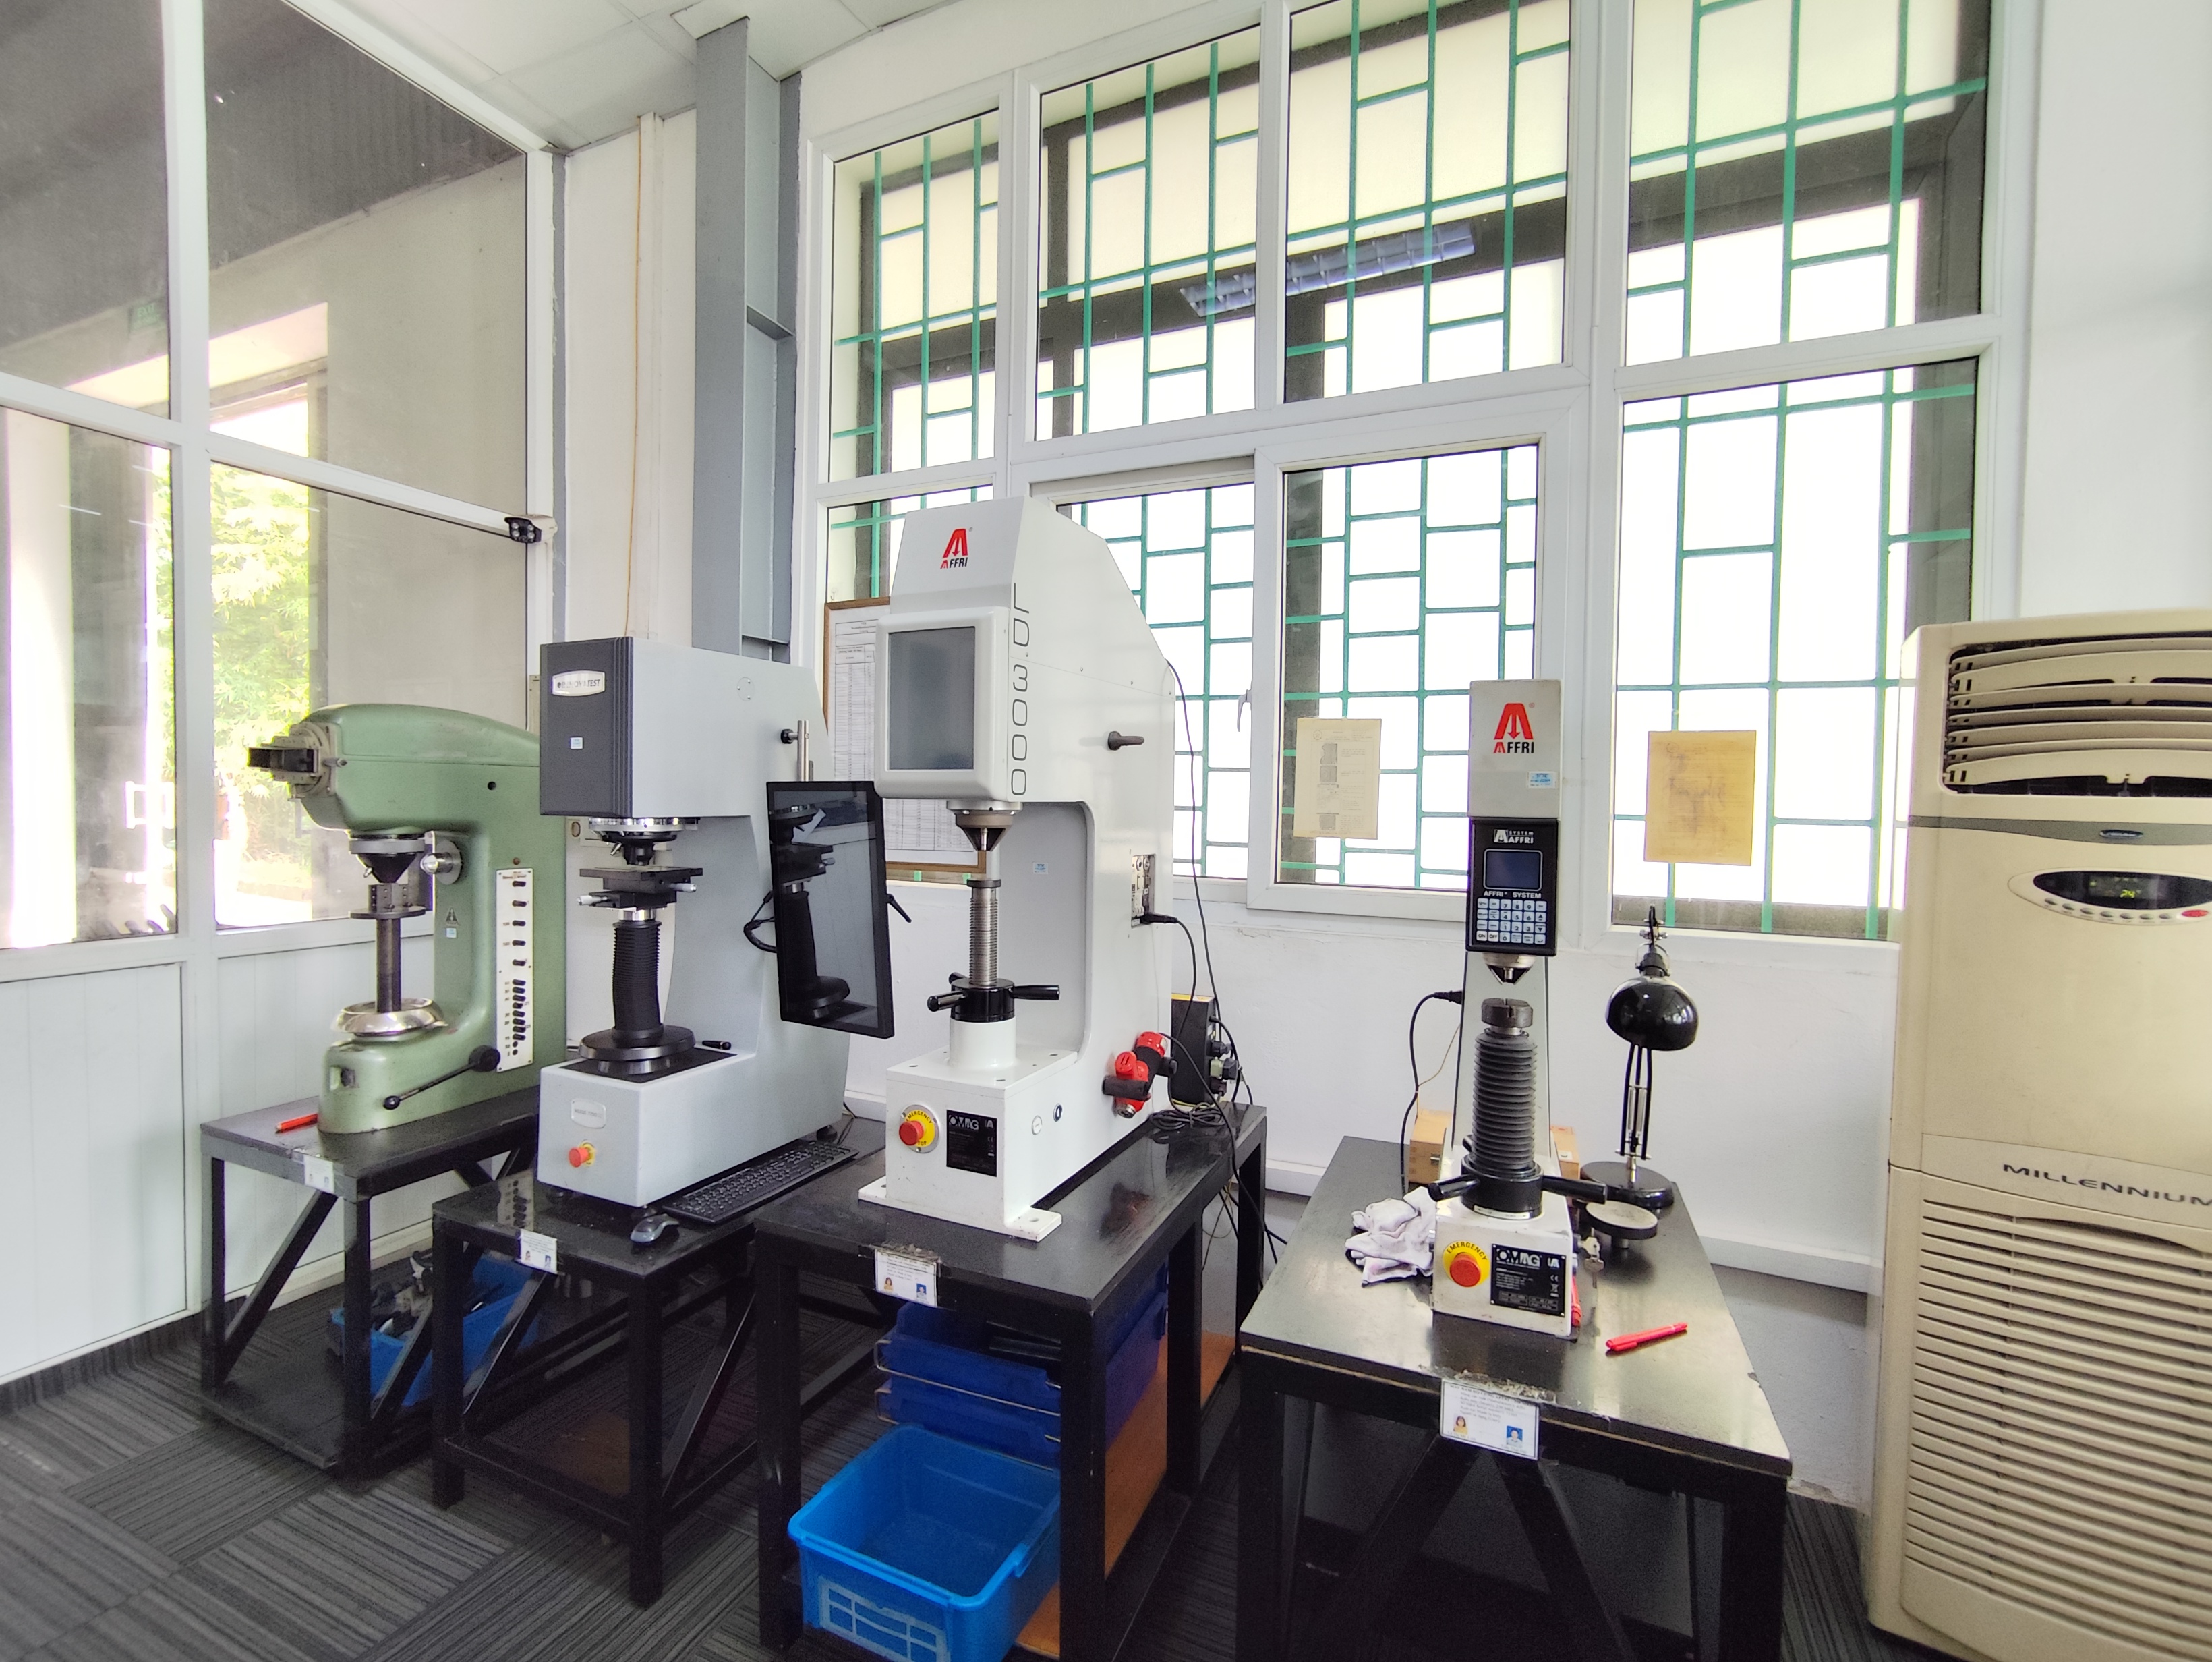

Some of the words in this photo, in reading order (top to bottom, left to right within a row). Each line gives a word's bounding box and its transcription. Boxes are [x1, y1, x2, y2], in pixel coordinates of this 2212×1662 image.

[940, 557, 968, 569] AFFRI
[1493, 741, 1534, 753] AFFRI
[2120, 889, 2136, 898] 24
[1447, 1242, 1488, 1261] EMERGENCY
